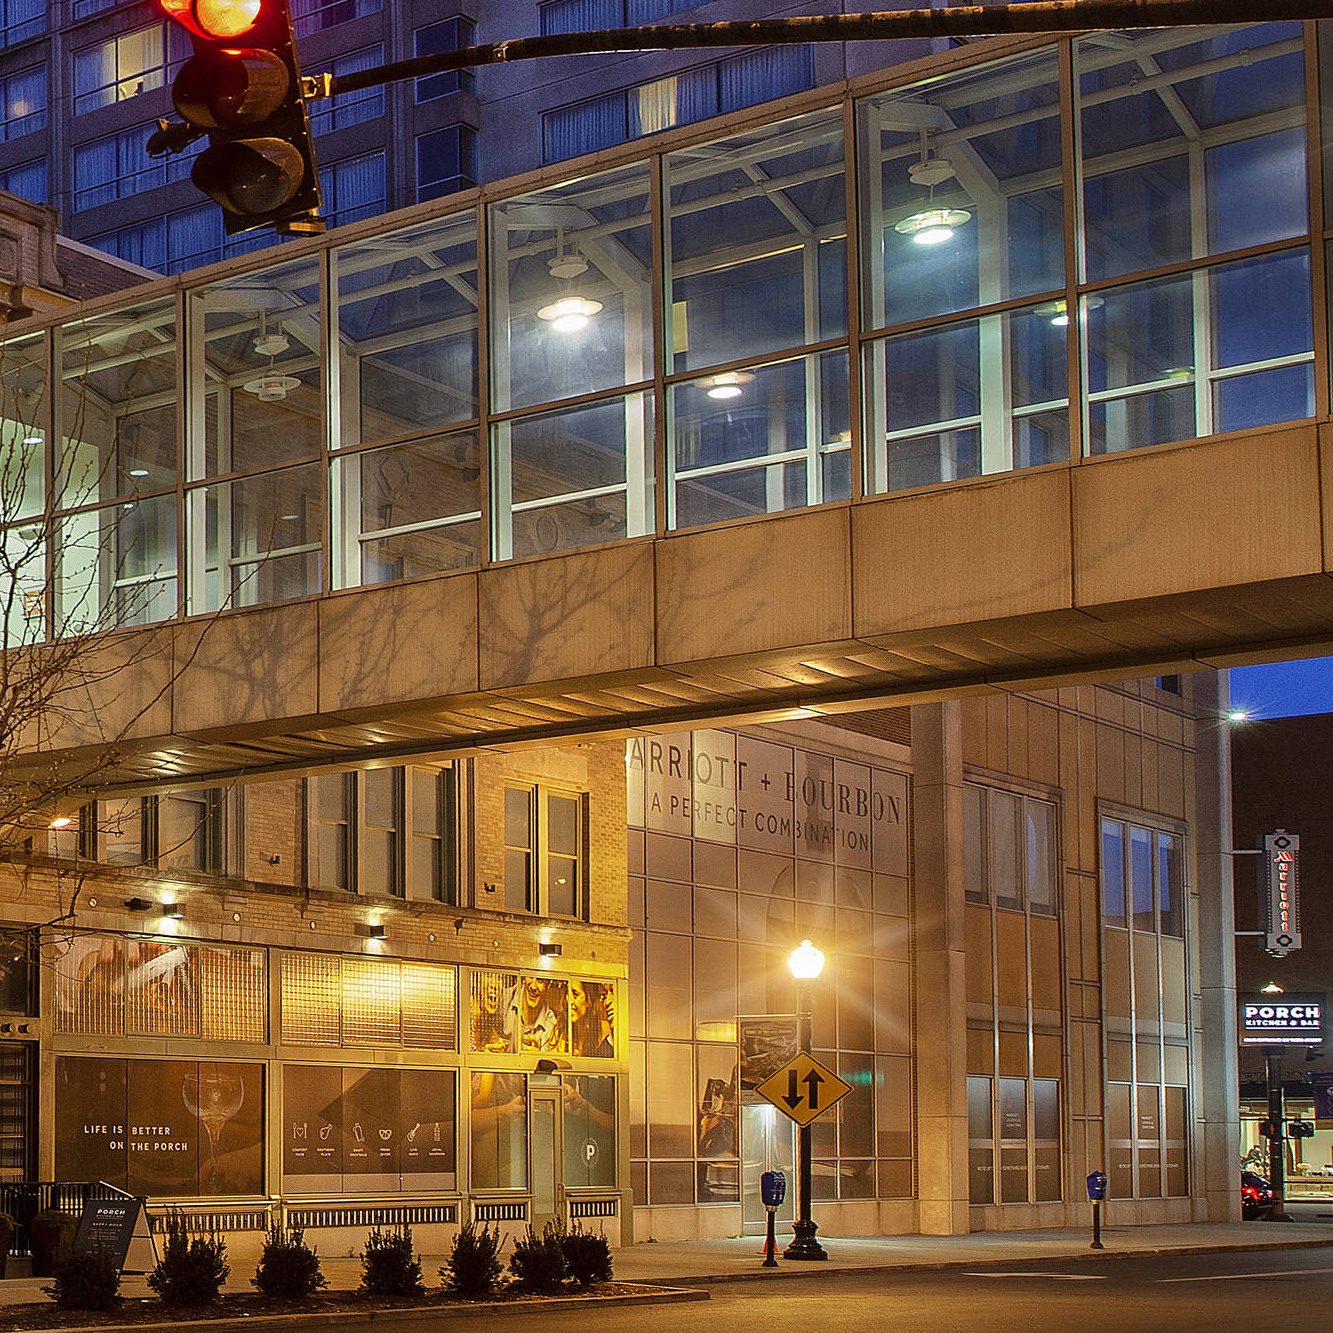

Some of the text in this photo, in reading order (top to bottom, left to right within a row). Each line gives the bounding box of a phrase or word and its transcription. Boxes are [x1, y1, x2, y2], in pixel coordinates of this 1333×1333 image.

[784, 770, 901, 826] BOURBON
[651, 792, 869, 852] A PERFECT COMBINATION
[1273, 851, 1294, 933] Marriott
[1244, 1006, 1321, 1019] PORCH
[84, 1125, 171, 1136] LIFE IS BETTER
[109, 1141, 189, 1152] ON THE PORCH
